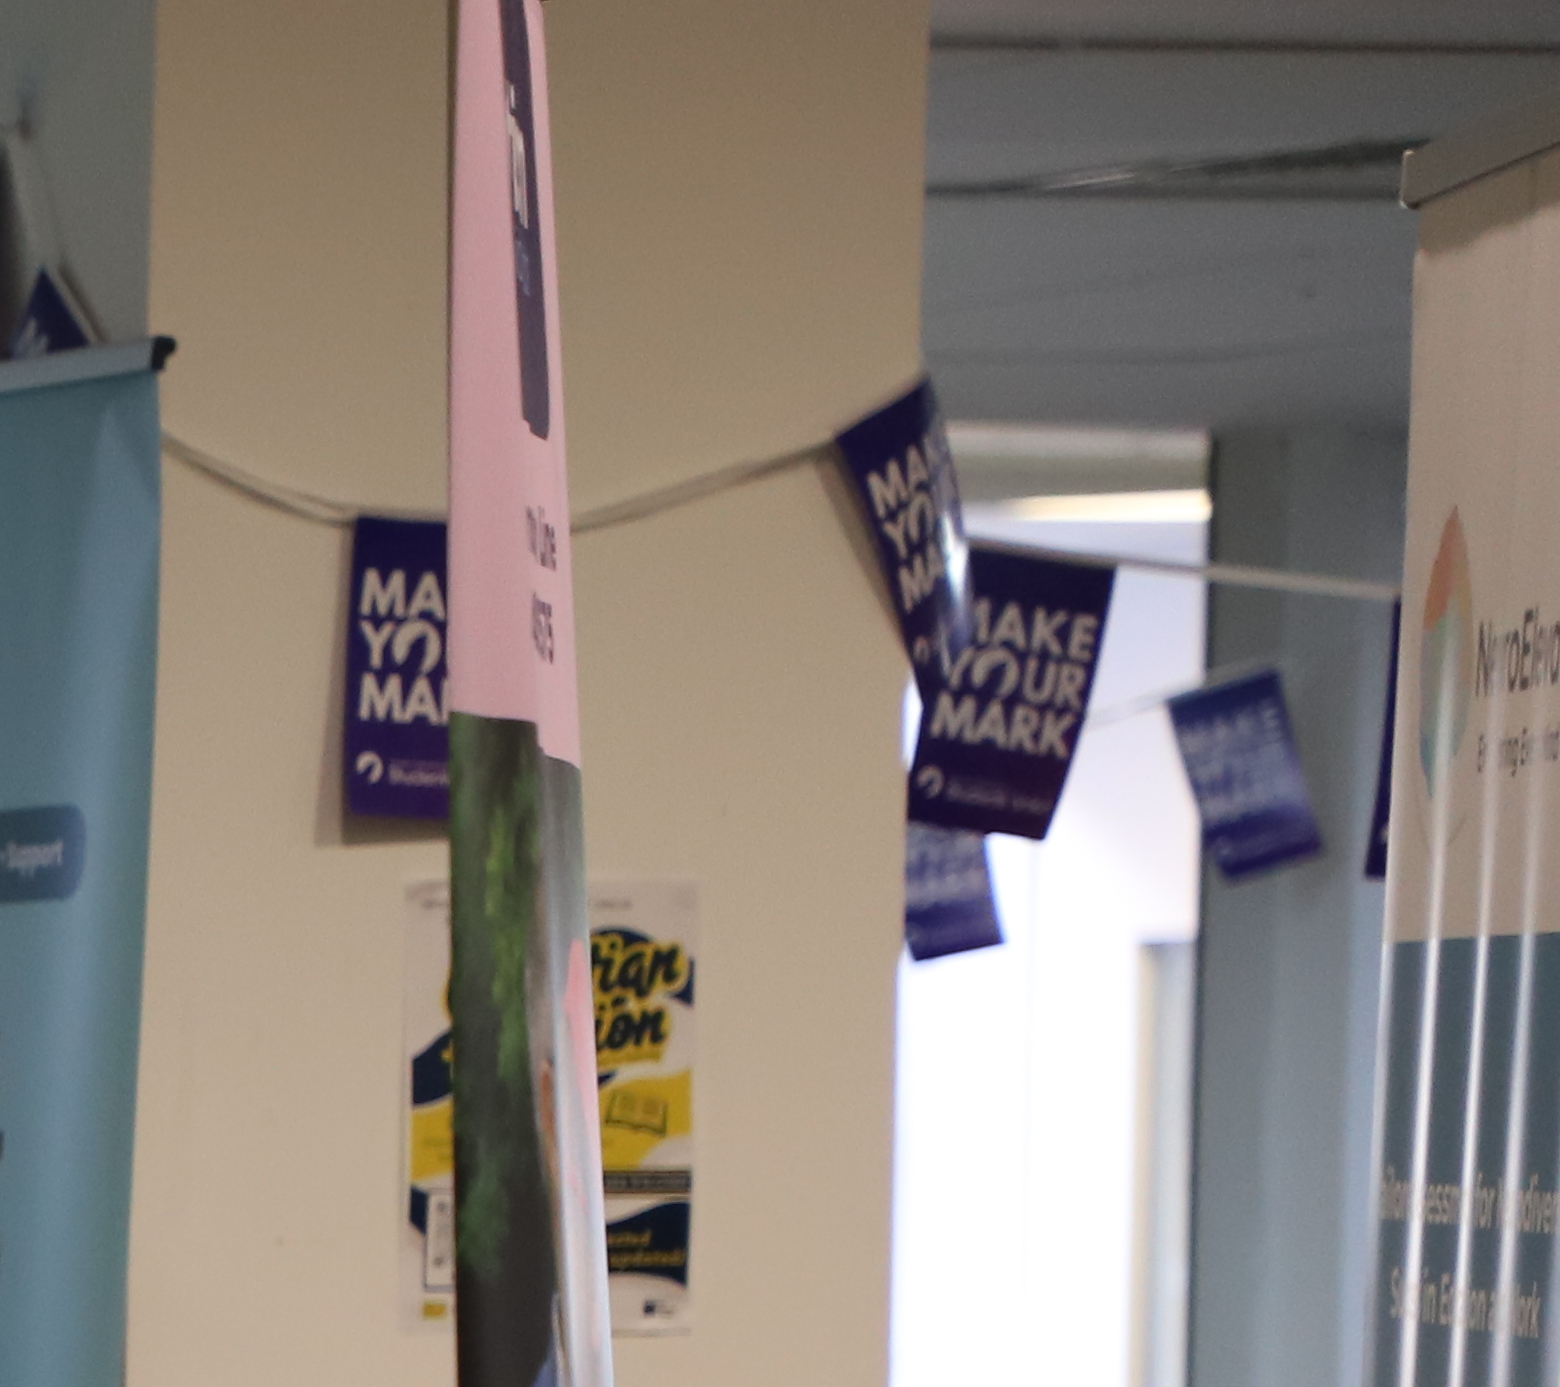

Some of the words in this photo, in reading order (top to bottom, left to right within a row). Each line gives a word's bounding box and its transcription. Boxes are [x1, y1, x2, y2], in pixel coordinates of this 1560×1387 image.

[359, 567, 447, 622] MA
[357, 618, 443, 675] YO
[357, 670, 449, 727] MA
[941, 644, 1087, 712] YOUR
[930, 691, 1076, 759] MARK
